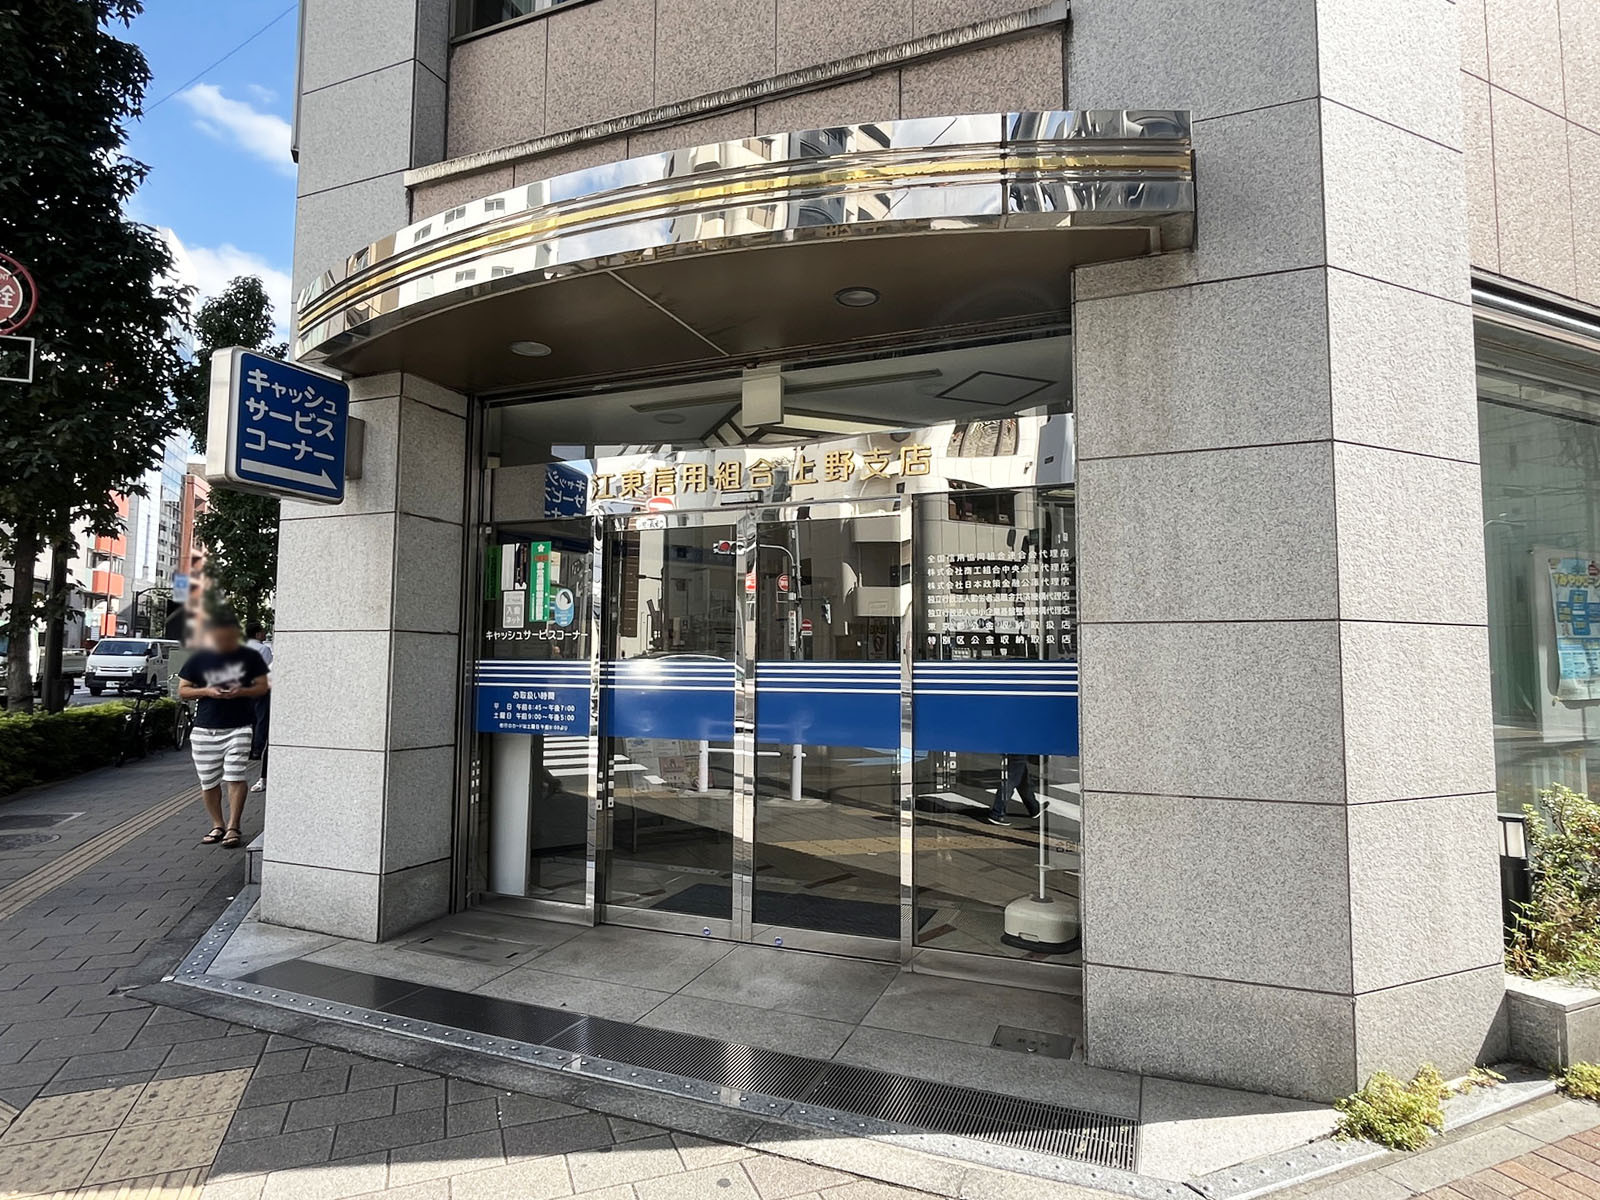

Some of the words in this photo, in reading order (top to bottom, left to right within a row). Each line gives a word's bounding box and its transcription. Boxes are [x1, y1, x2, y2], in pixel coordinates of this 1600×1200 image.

[247, 368, 337, 415] キャッシュ
[245, 396, 335, 441] サービス
[245, 427, 335, 461] コーナー
[927, 563, 1070, 577] 株式会社商工組合中央金庫代理店
[927, 577, 1070, 590] 株式会社日本政策金融公庫代理店
[485, 630, 588, 640] キャッシュサービスコーナー
[512, 691, 556, 700] お取扱い時間
[493, 711, 512, 719] 土曜日
